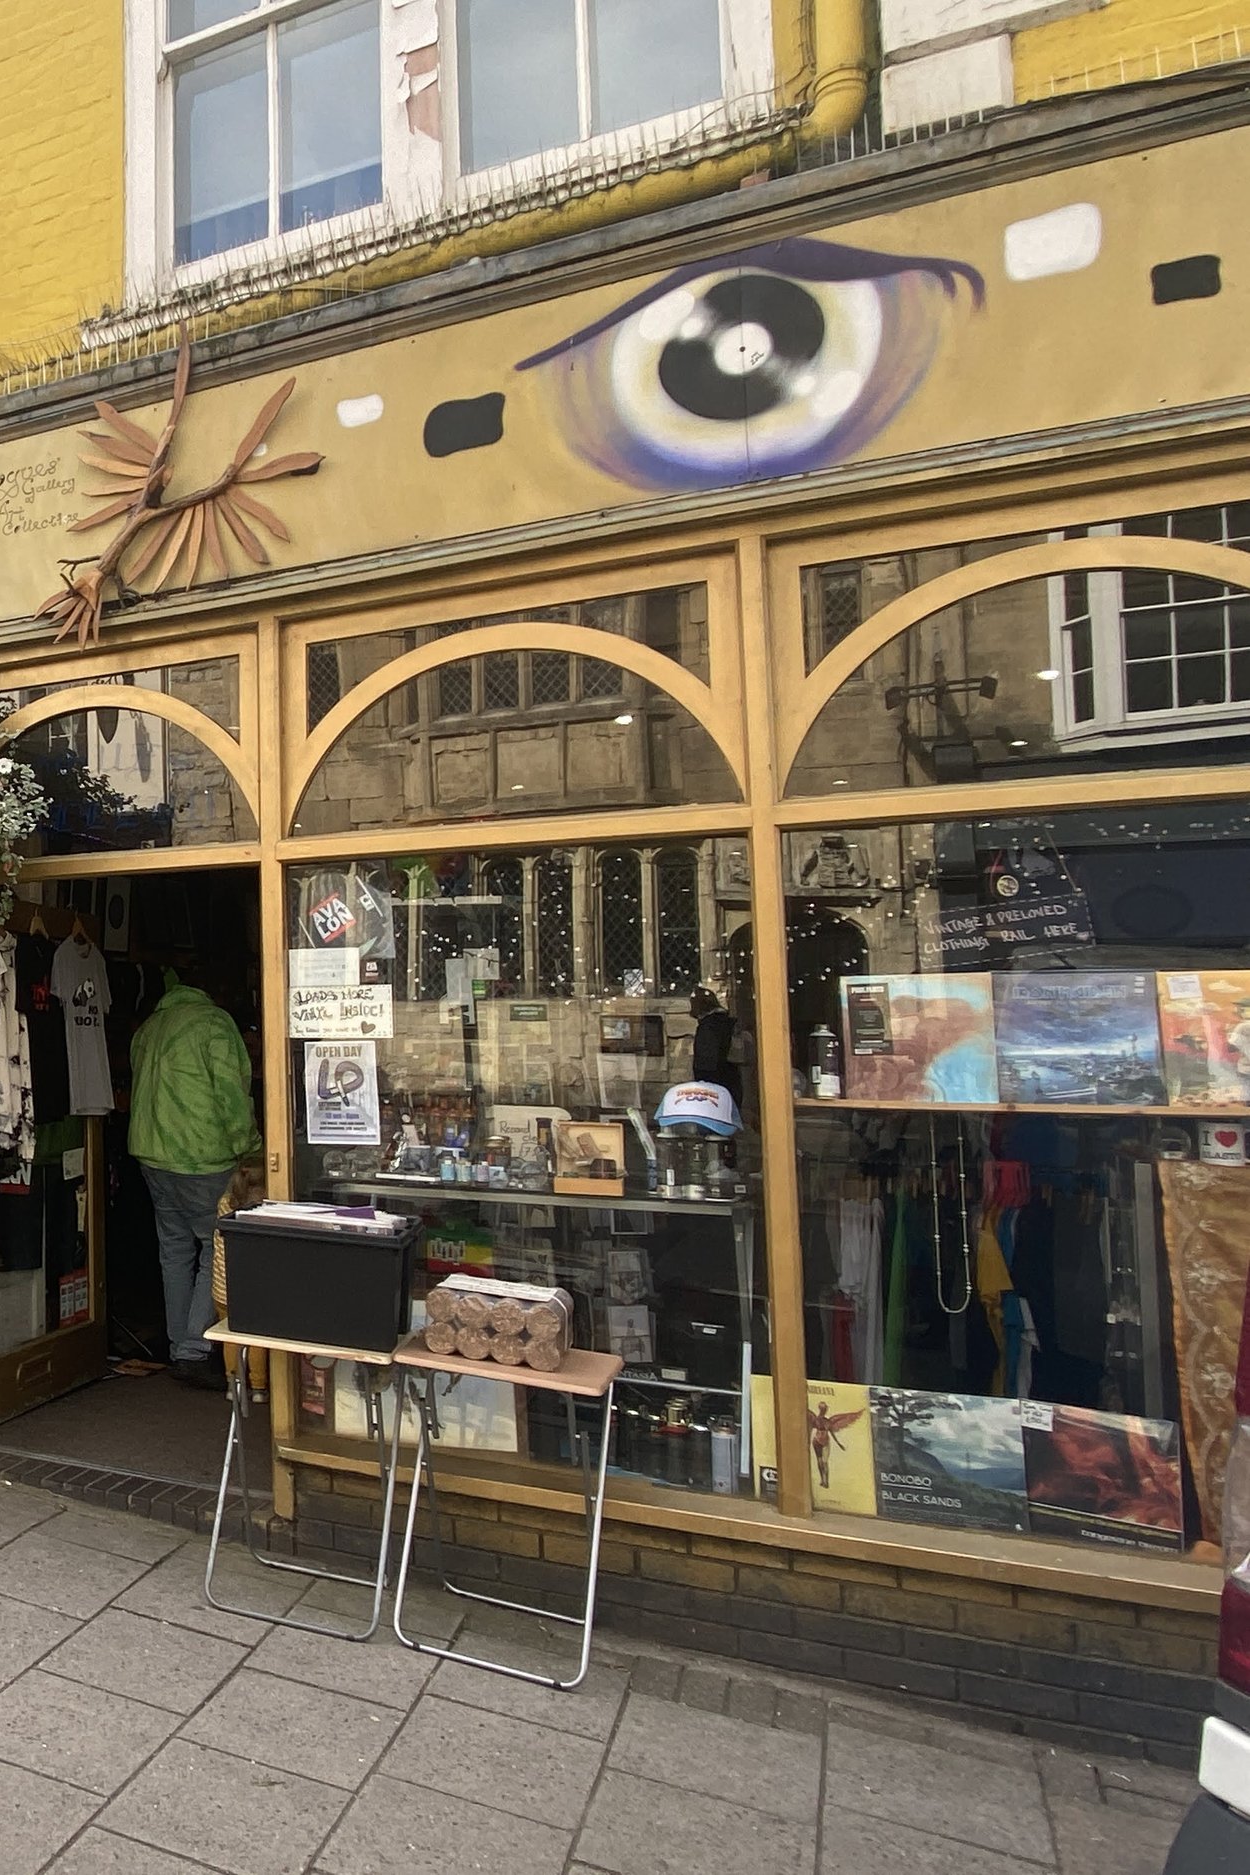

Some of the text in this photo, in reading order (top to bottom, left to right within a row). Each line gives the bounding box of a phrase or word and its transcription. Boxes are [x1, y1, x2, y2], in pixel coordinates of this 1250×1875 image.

[22, 476, 75, 504] Gallery
[924, 904, 1067, 935] VINTAGE & PRELOVED
[924, 922, 1079, 954] CLOTHING RAIL HERE
[341, 987, 374, 1000] MORE
[316, 1046, 362, 1058] OPEN DAY
[1202, 1130, 1211, 1146] I
[880, 1472, 932, 1487] BONOBO
[881, 1490, 962, 1509] BLACK SANDS
